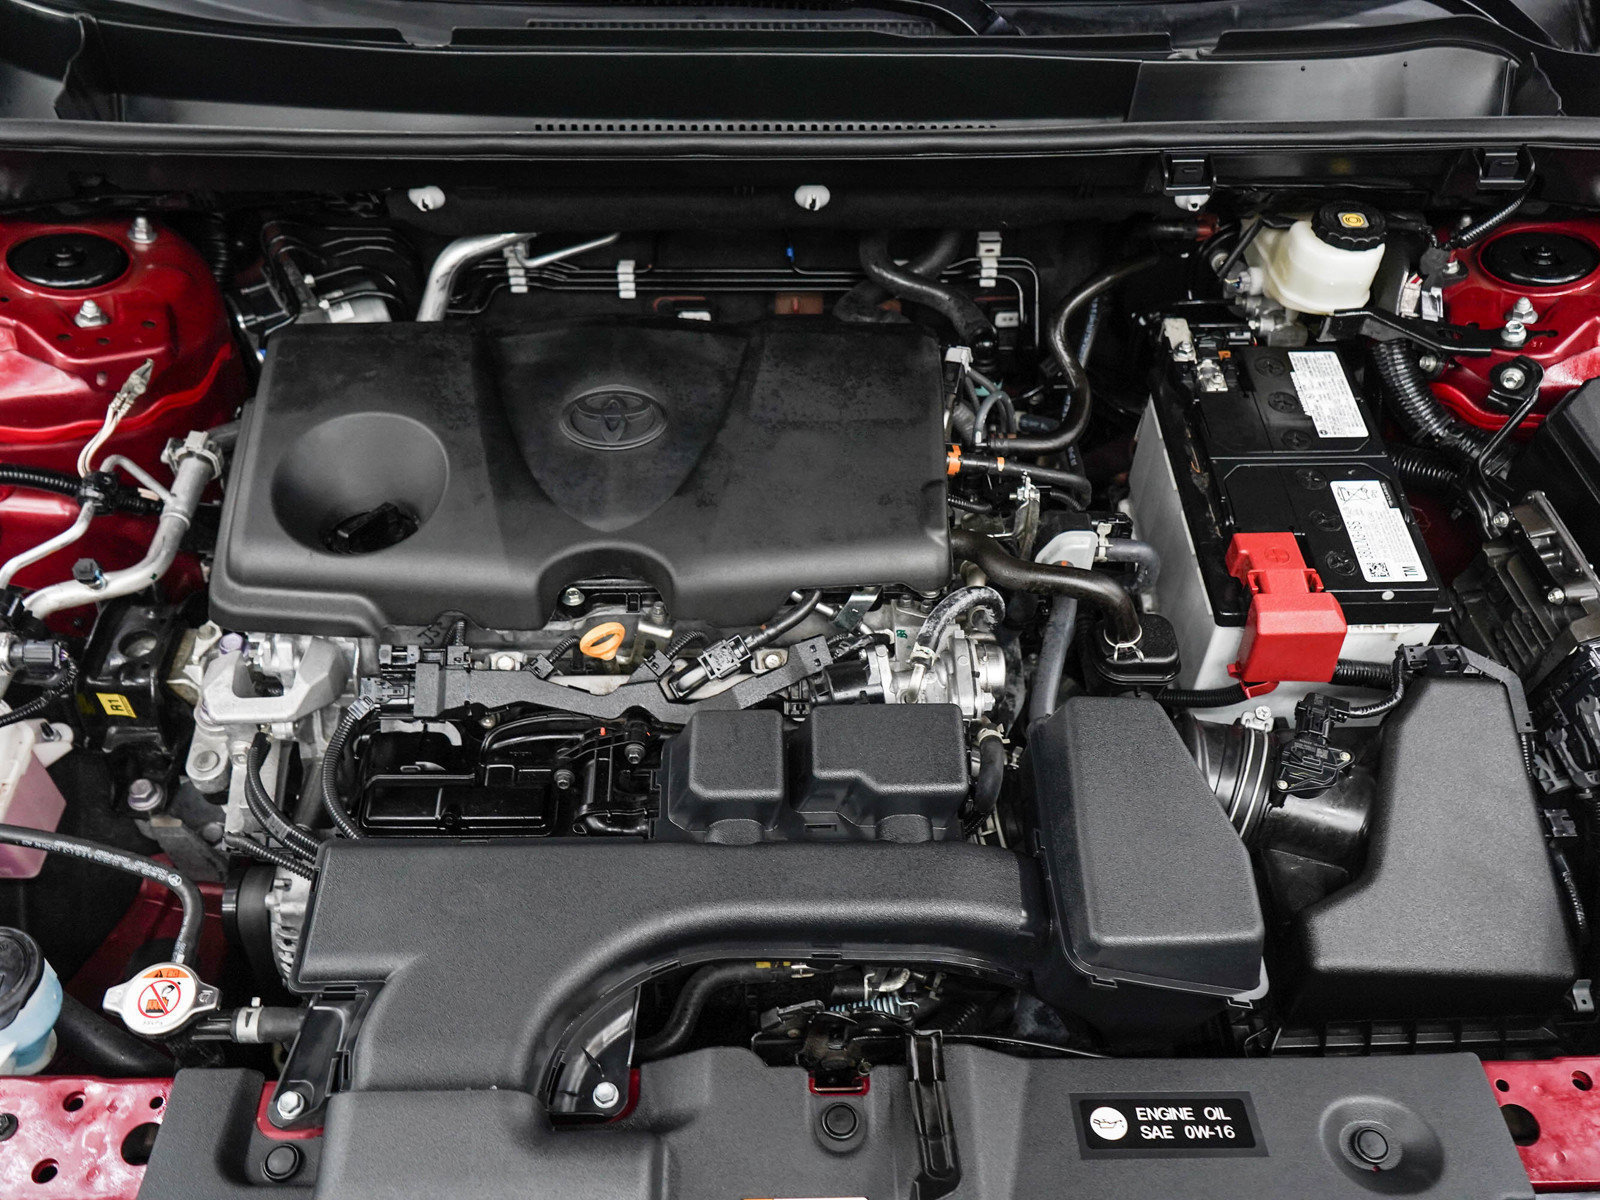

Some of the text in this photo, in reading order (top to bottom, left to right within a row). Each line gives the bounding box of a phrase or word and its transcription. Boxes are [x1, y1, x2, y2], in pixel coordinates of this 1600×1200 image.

[1402, 565, 1419, 577] TM
[107, 699, 125, 711] R1
[1135, 1107, 1231, 1121] ENGINE OIL
[1140, 1125, 1236, 1139] SAE 0W-16
